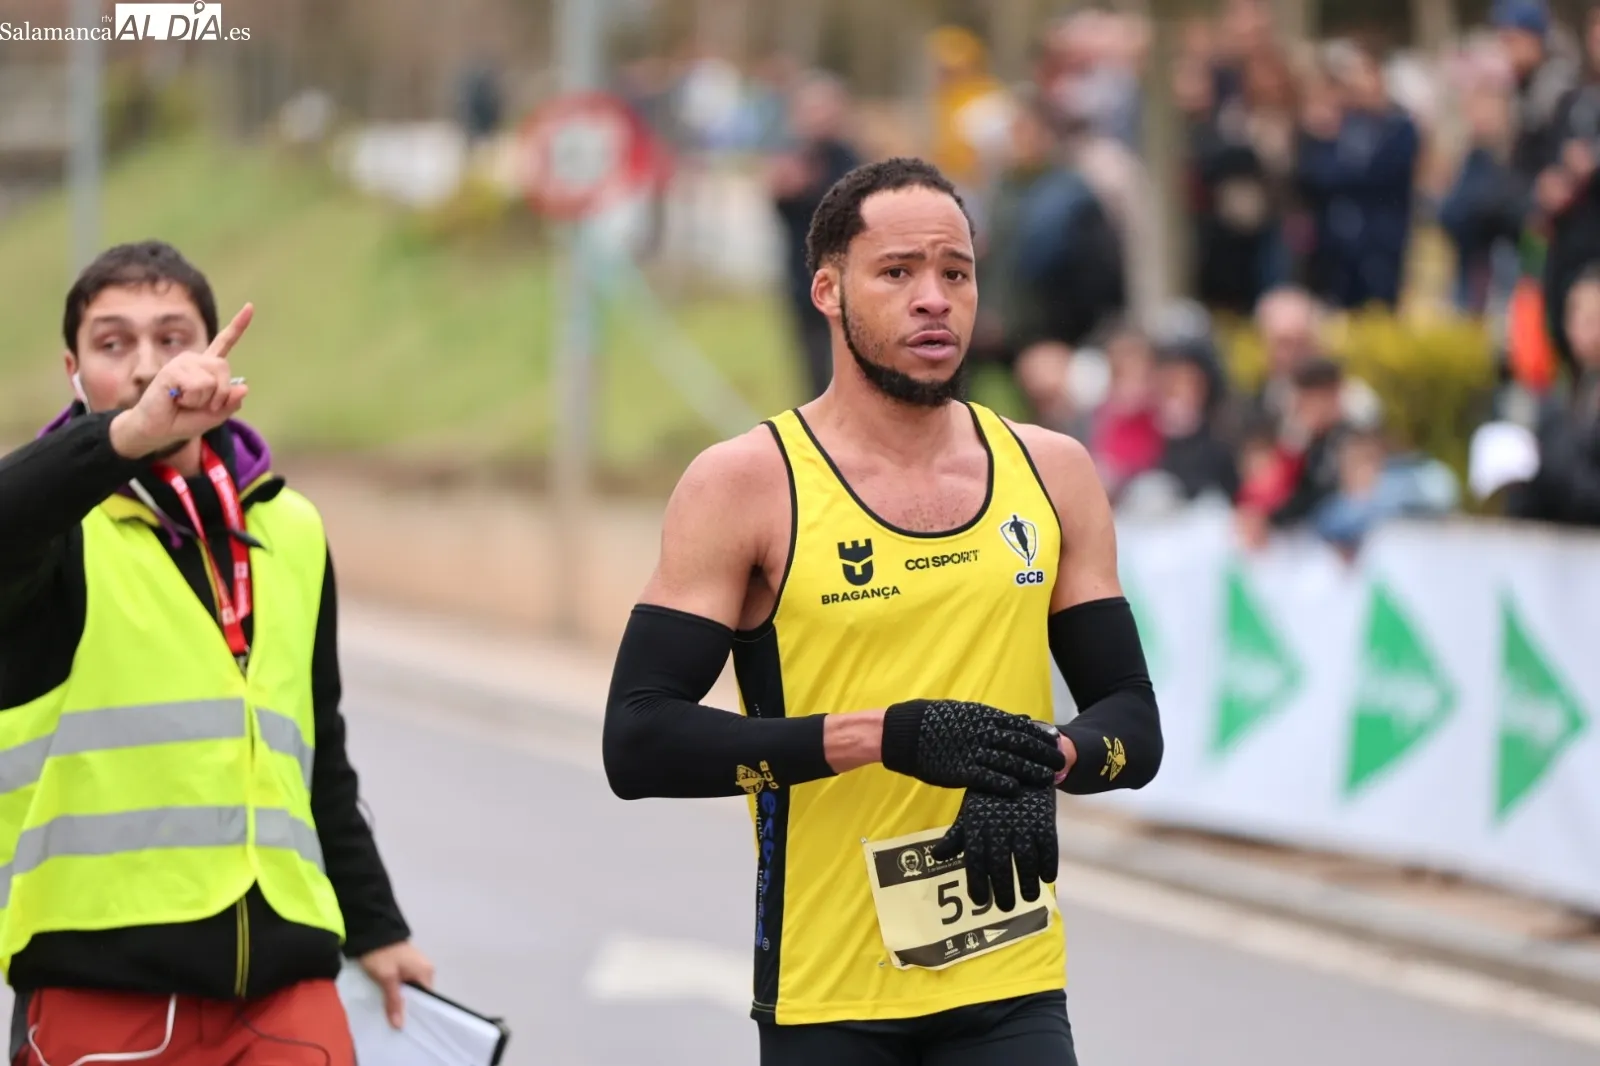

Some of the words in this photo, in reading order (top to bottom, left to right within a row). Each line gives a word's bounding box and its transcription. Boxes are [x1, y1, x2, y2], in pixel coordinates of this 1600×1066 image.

[904, 556, 931, 571] CCI
[931, 549, 980, 568] SPORT
[1016, 571, 1044, 584] GCB
[821, 585, 901, 605] BRAGANÇA
